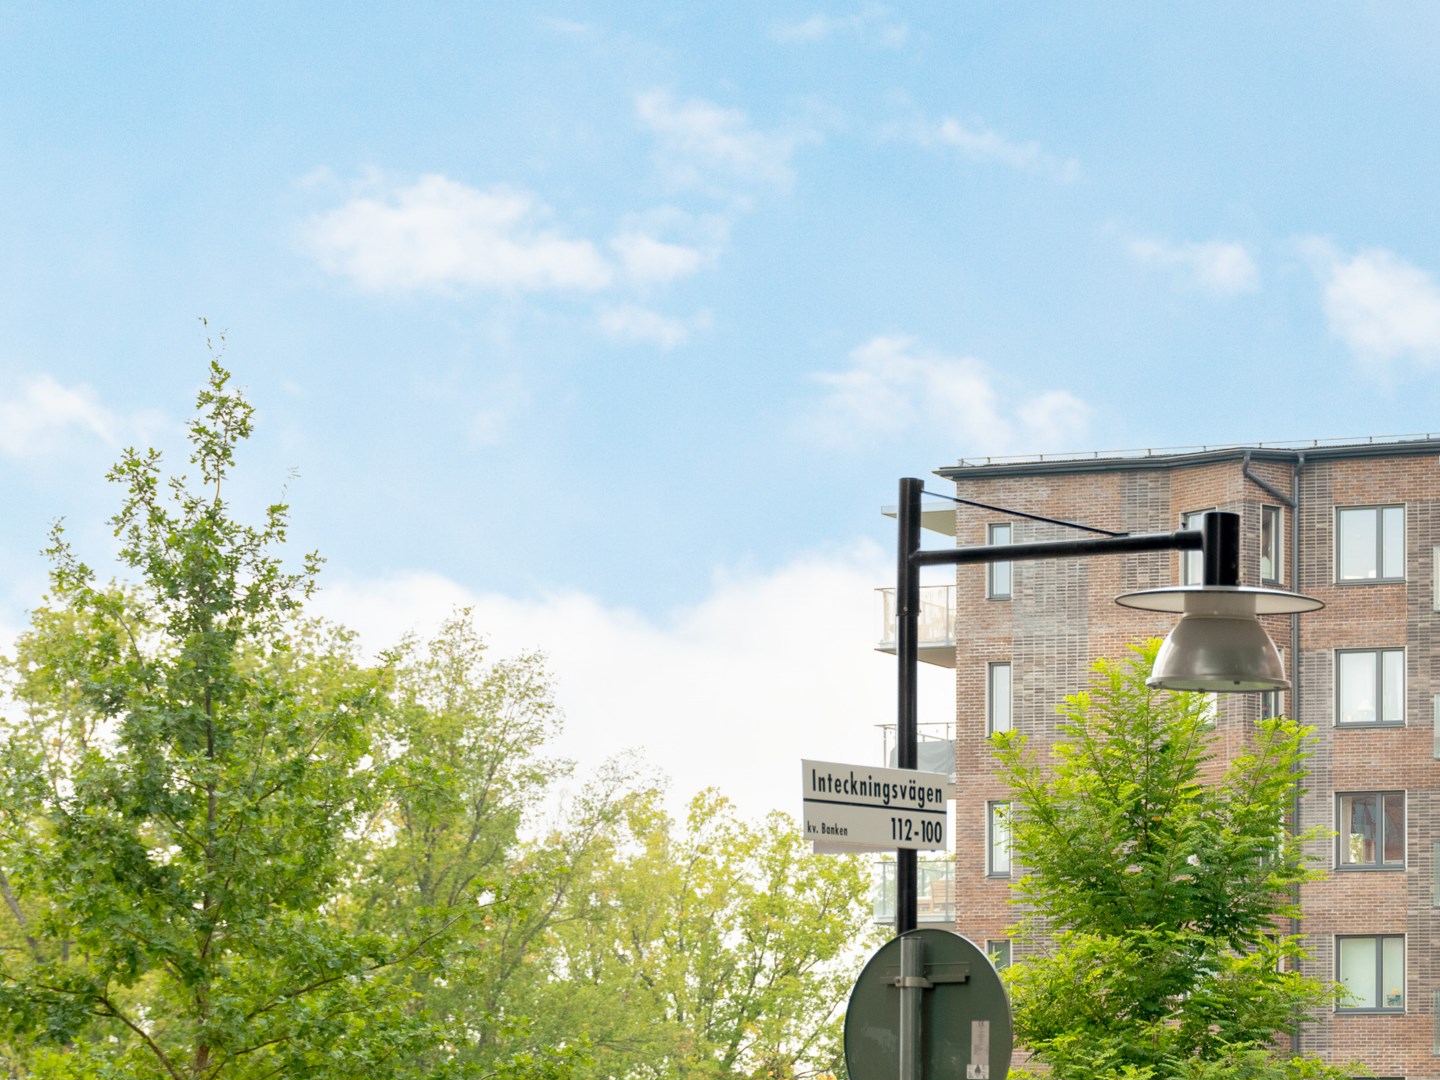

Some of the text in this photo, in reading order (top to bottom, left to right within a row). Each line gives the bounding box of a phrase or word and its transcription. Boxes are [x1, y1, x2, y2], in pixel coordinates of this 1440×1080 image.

[812, 769, 942, 808] Inteckningsvägen
[807, 820, 848, 836] kv. Banken
[891, 817, 942, 844] 112-100
